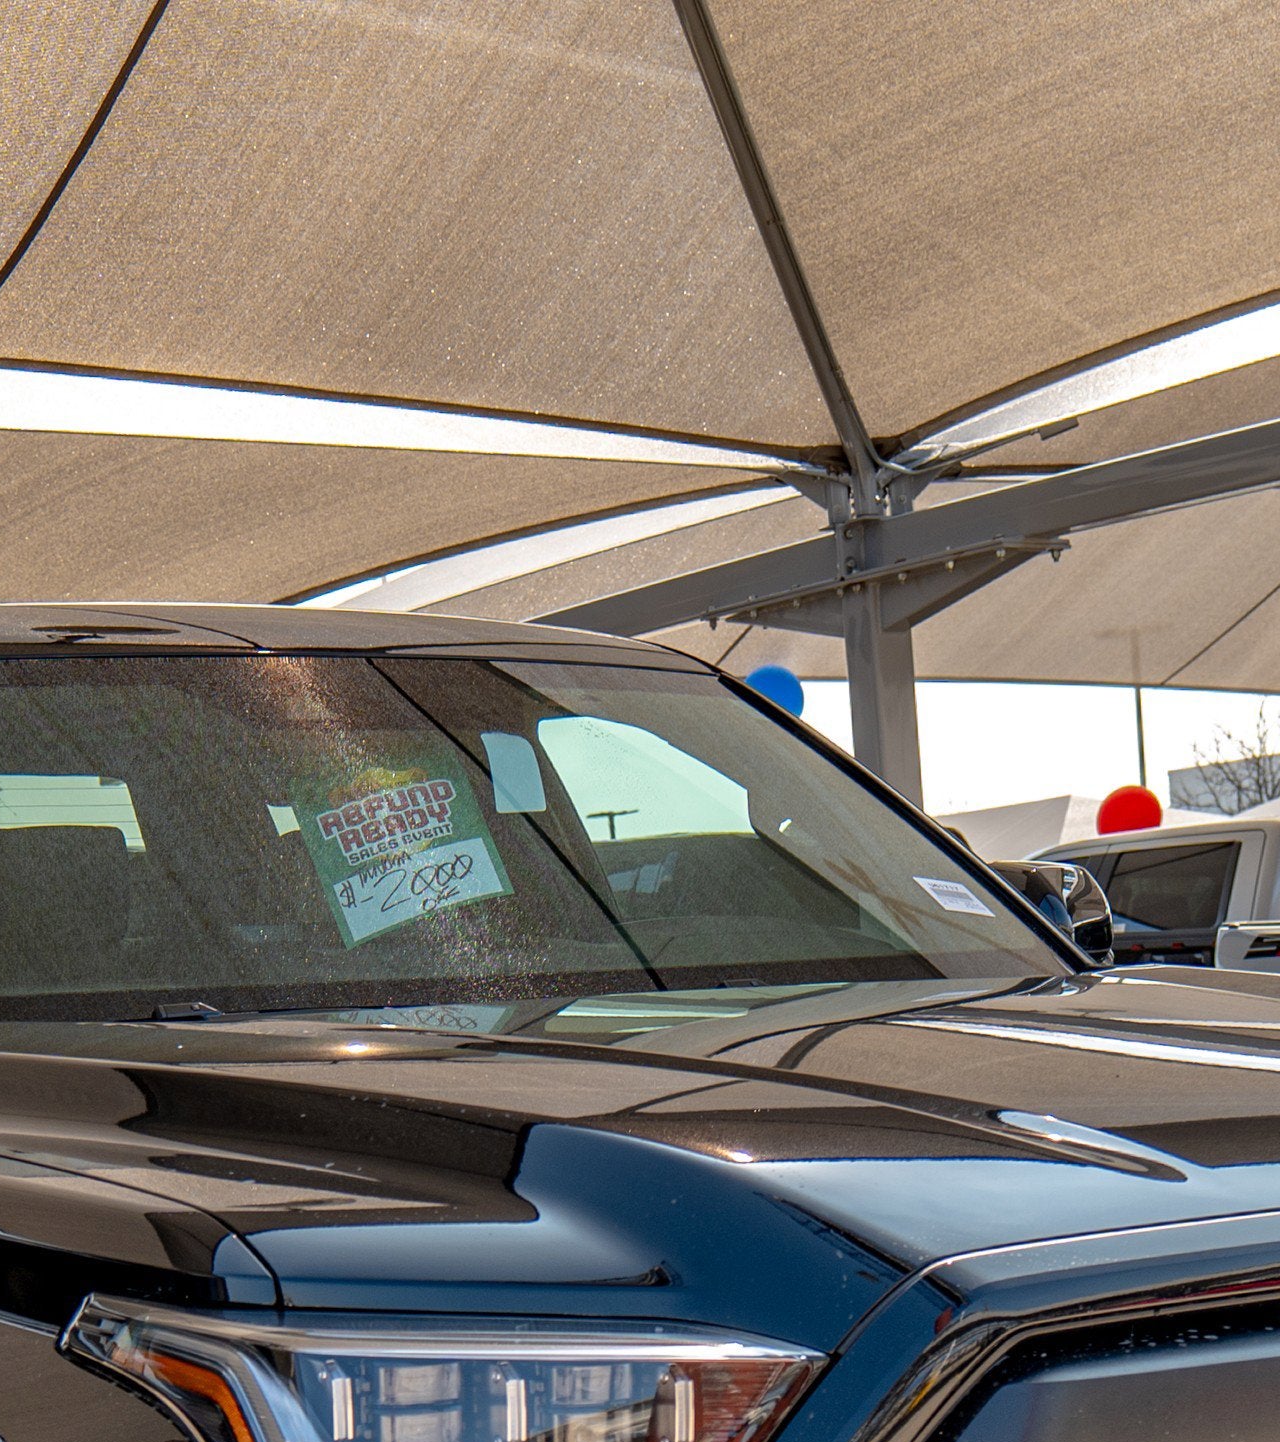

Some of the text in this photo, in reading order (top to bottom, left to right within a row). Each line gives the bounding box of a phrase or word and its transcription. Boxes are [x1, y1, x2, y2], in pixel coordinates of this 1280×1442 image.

[318, 779, 457, 839] REFUND
[337, 801, 451, 855] READY
[349, 823, 452, 864] SALES EVENT
